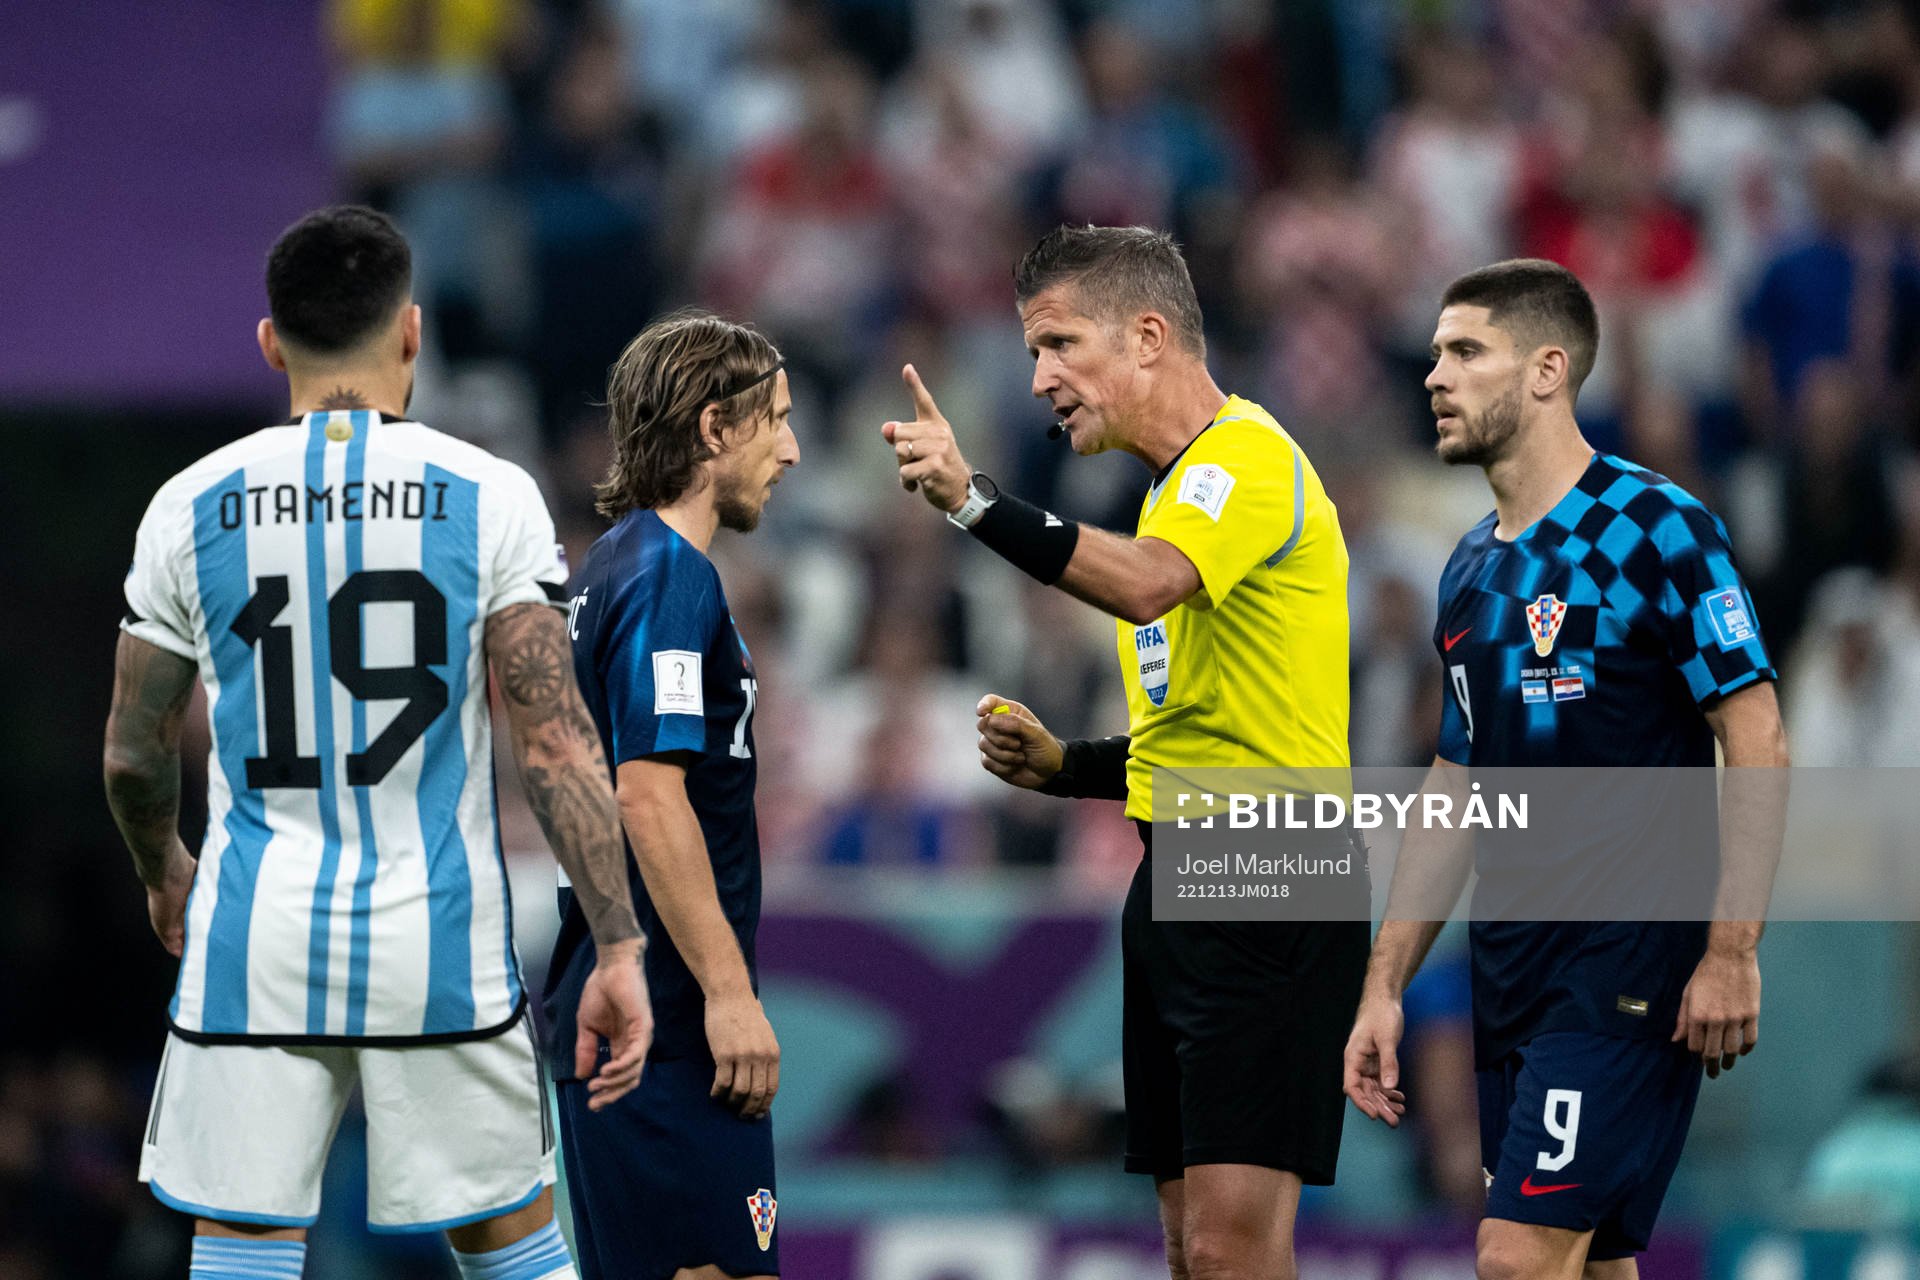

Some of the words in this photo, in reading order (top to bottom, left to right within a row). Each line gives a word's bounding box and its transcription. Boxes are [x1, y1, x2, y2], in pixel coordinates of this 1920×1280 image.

[219, 481, 448, 531] OTAMENDI
[1135, 625, 1165, 651] FIFA
[231, 569, 449, 789] 19
[1450, 664, 1474, 745] 9
[1536, 1088, 1582, 1172] 9
